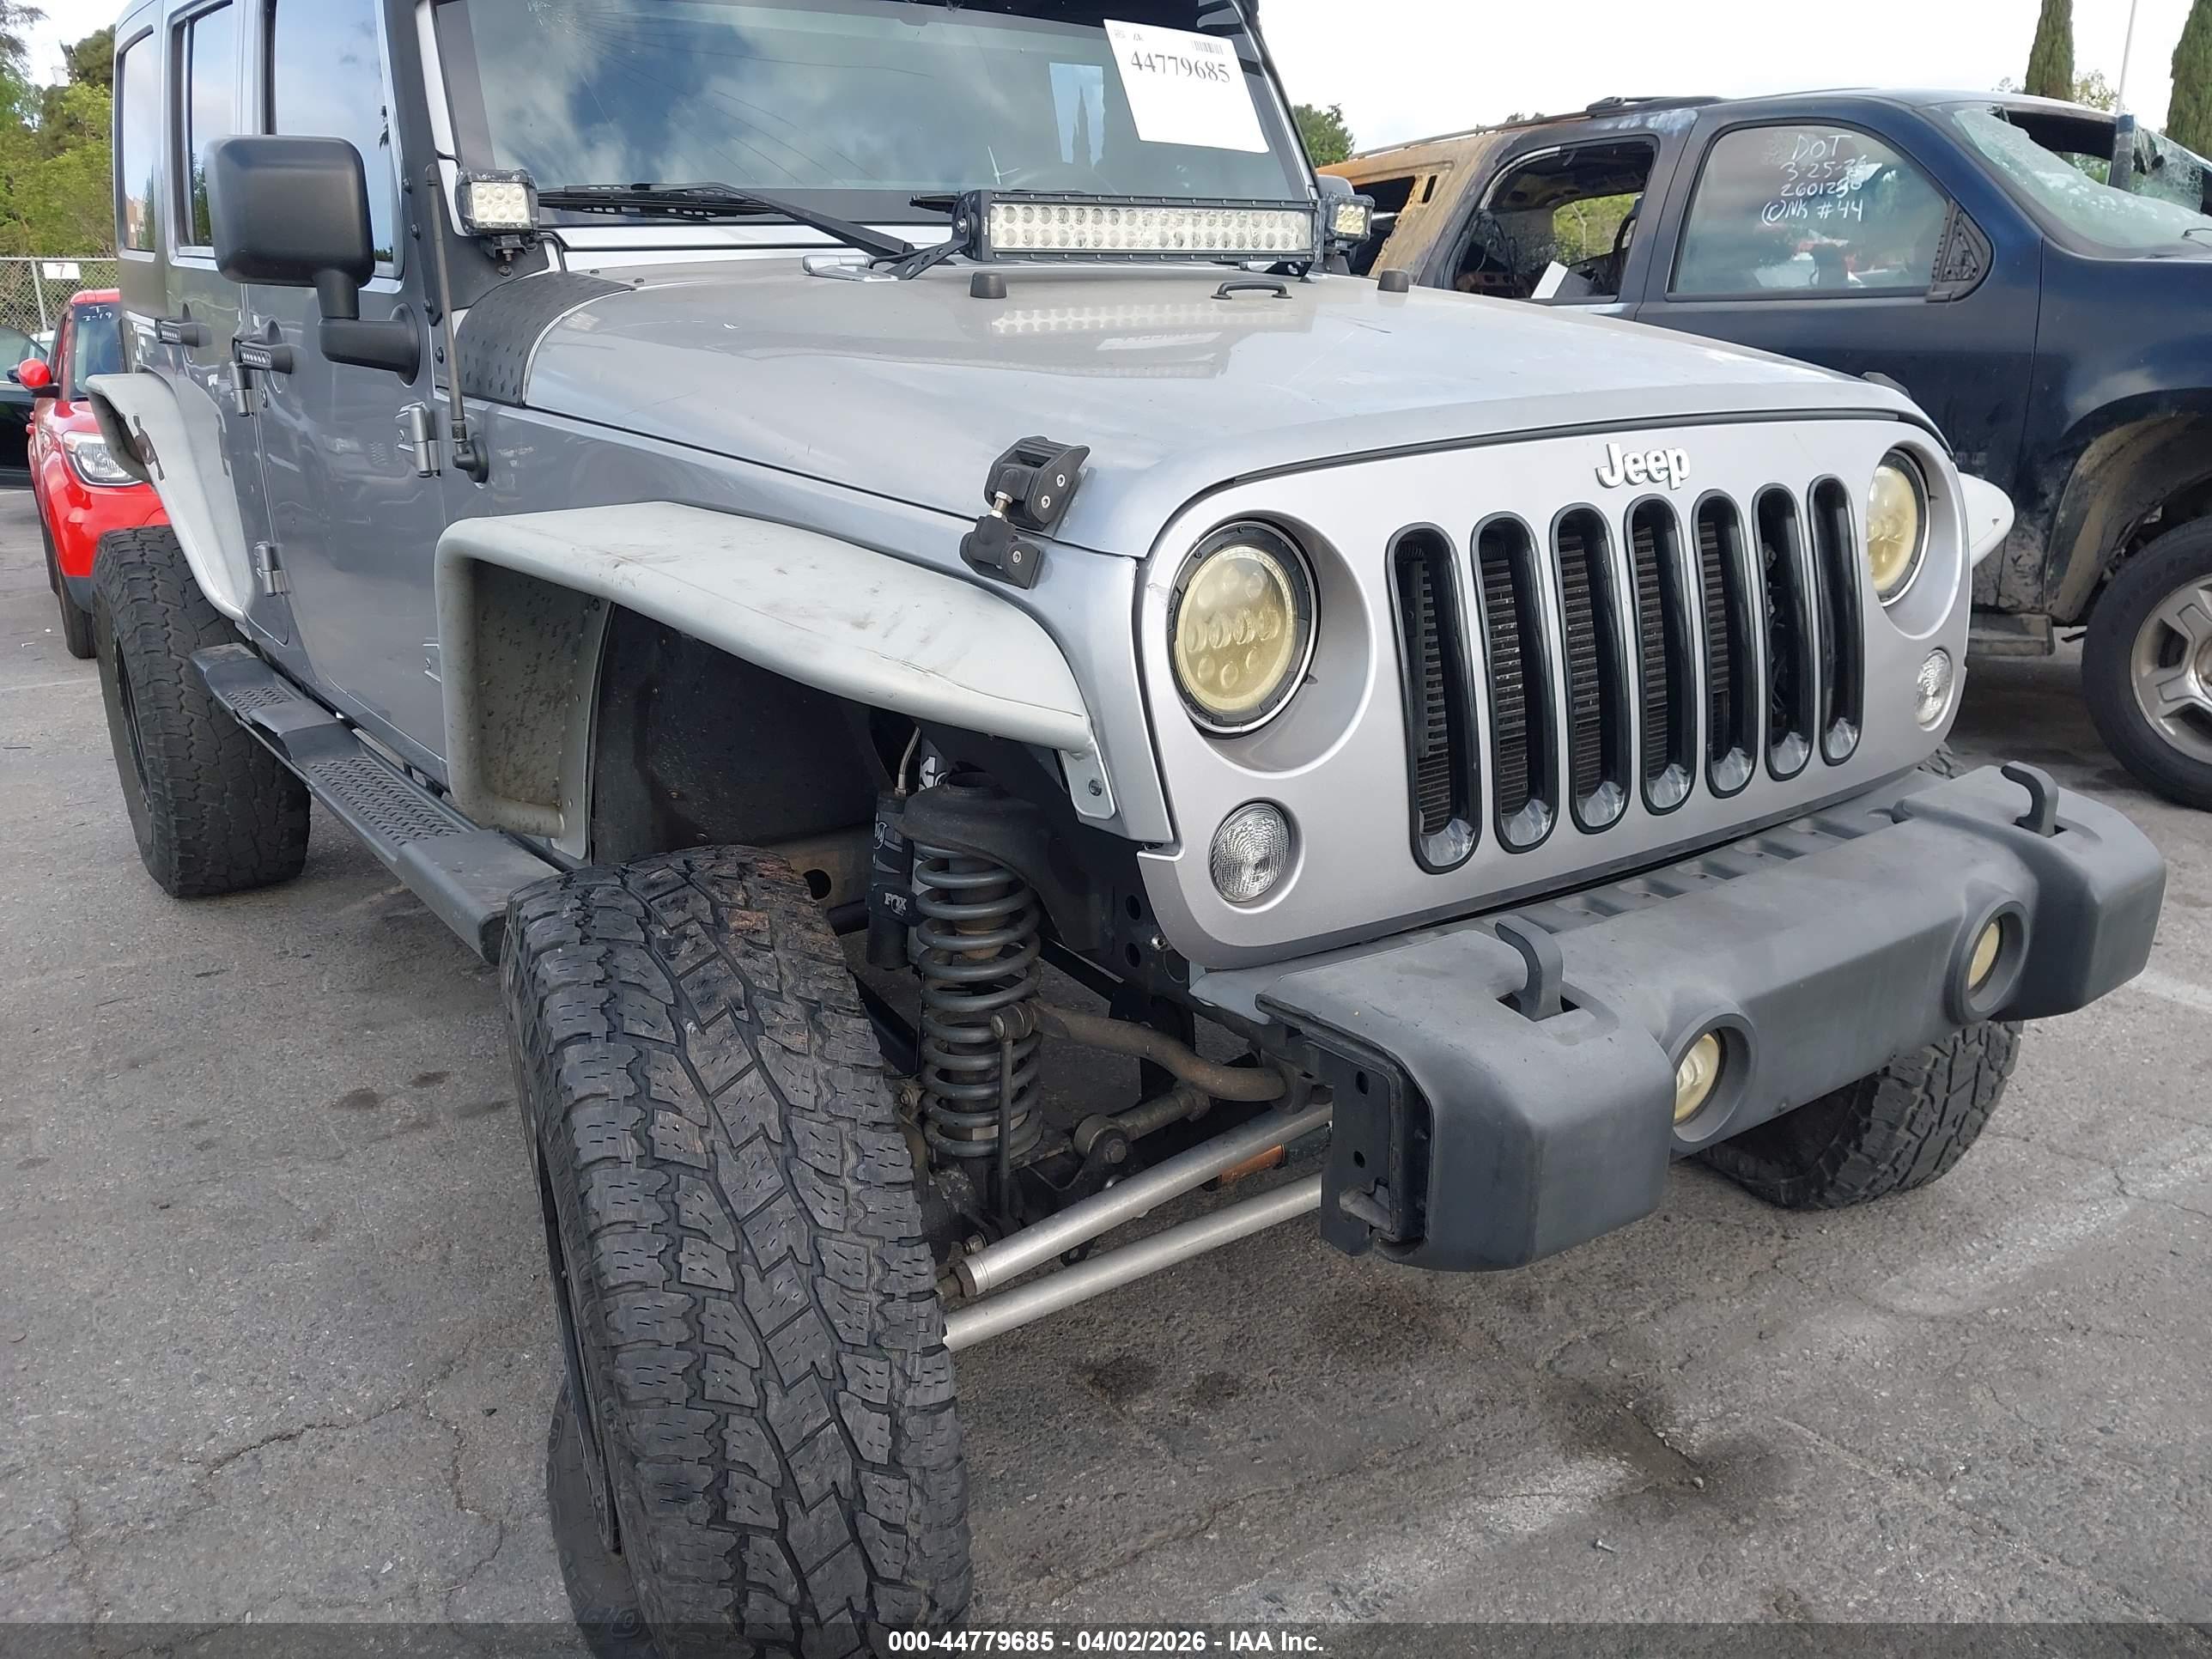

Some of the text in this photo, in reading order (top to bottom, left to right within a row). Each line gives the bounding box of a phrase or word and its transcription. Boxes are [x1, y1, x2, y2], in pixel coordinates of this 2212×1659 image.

[1130, 50, 1231, 83] 44779685
[1791, 133, 1853, 162] DOT
[56, 264, 65, 277] 7
[1595, 441, 1691, 491] Jeep
[884, 891, 908, 916] FOX
